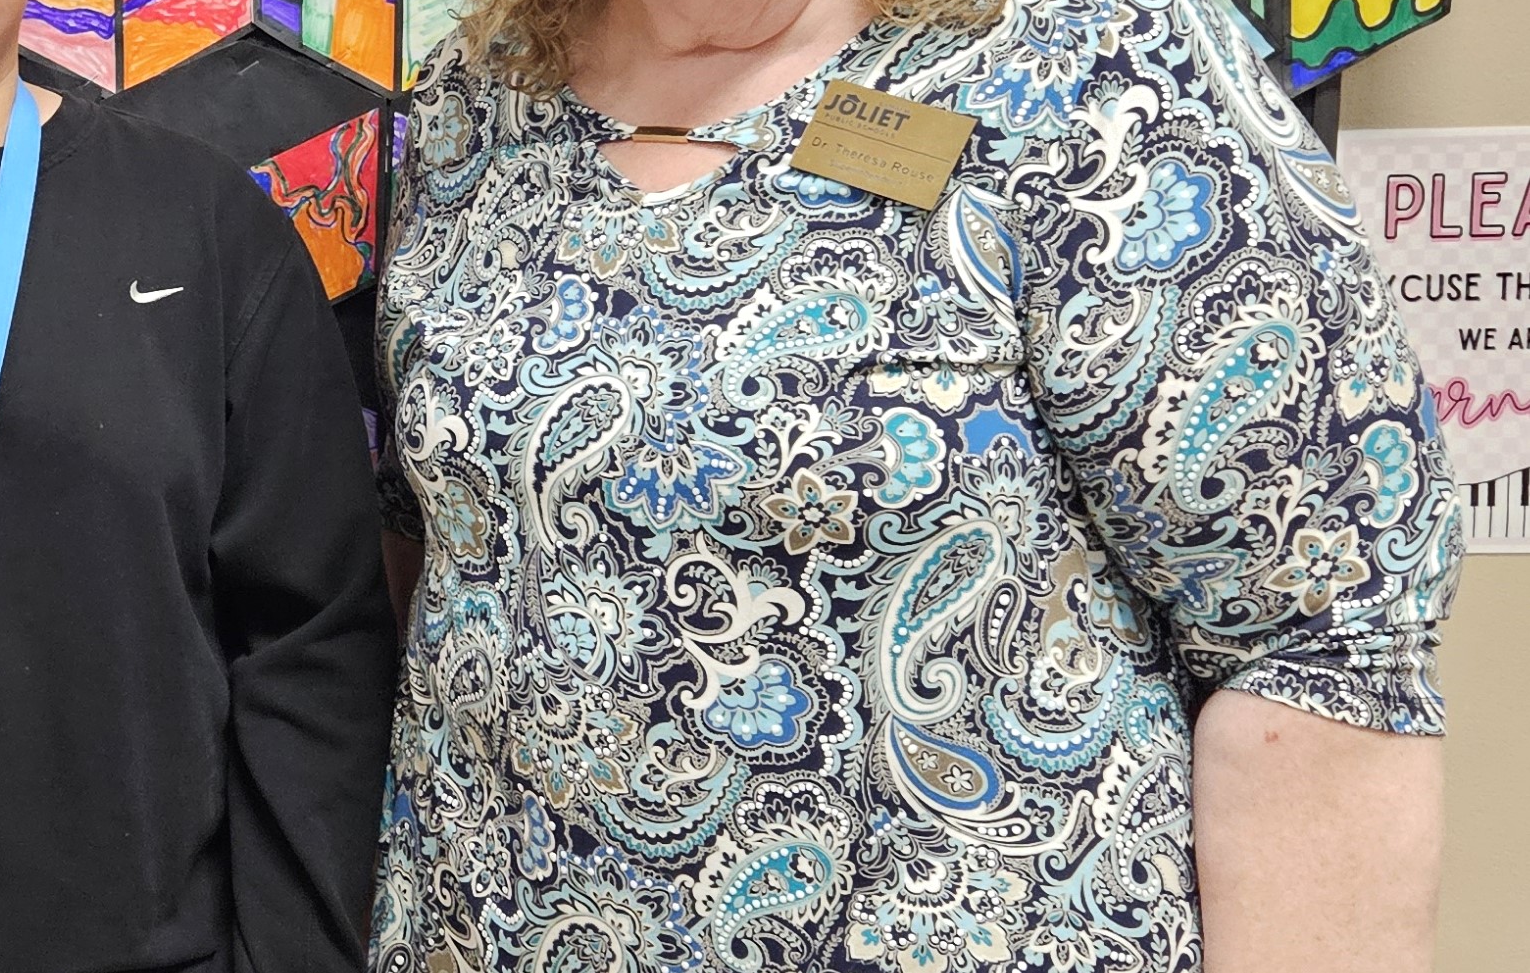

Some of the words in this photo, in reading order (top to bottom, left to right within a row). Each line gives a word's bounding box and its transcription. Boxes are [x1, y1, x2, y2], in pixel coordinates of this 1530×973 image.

[836, 143, 887, 169] Theresa
[890, 161, 935, 183] Rouse
[1386, 273, 1482, 303] CUSE
[1458, 327, 1498, 351] WE
[1507, 327, 1530, 351] A
